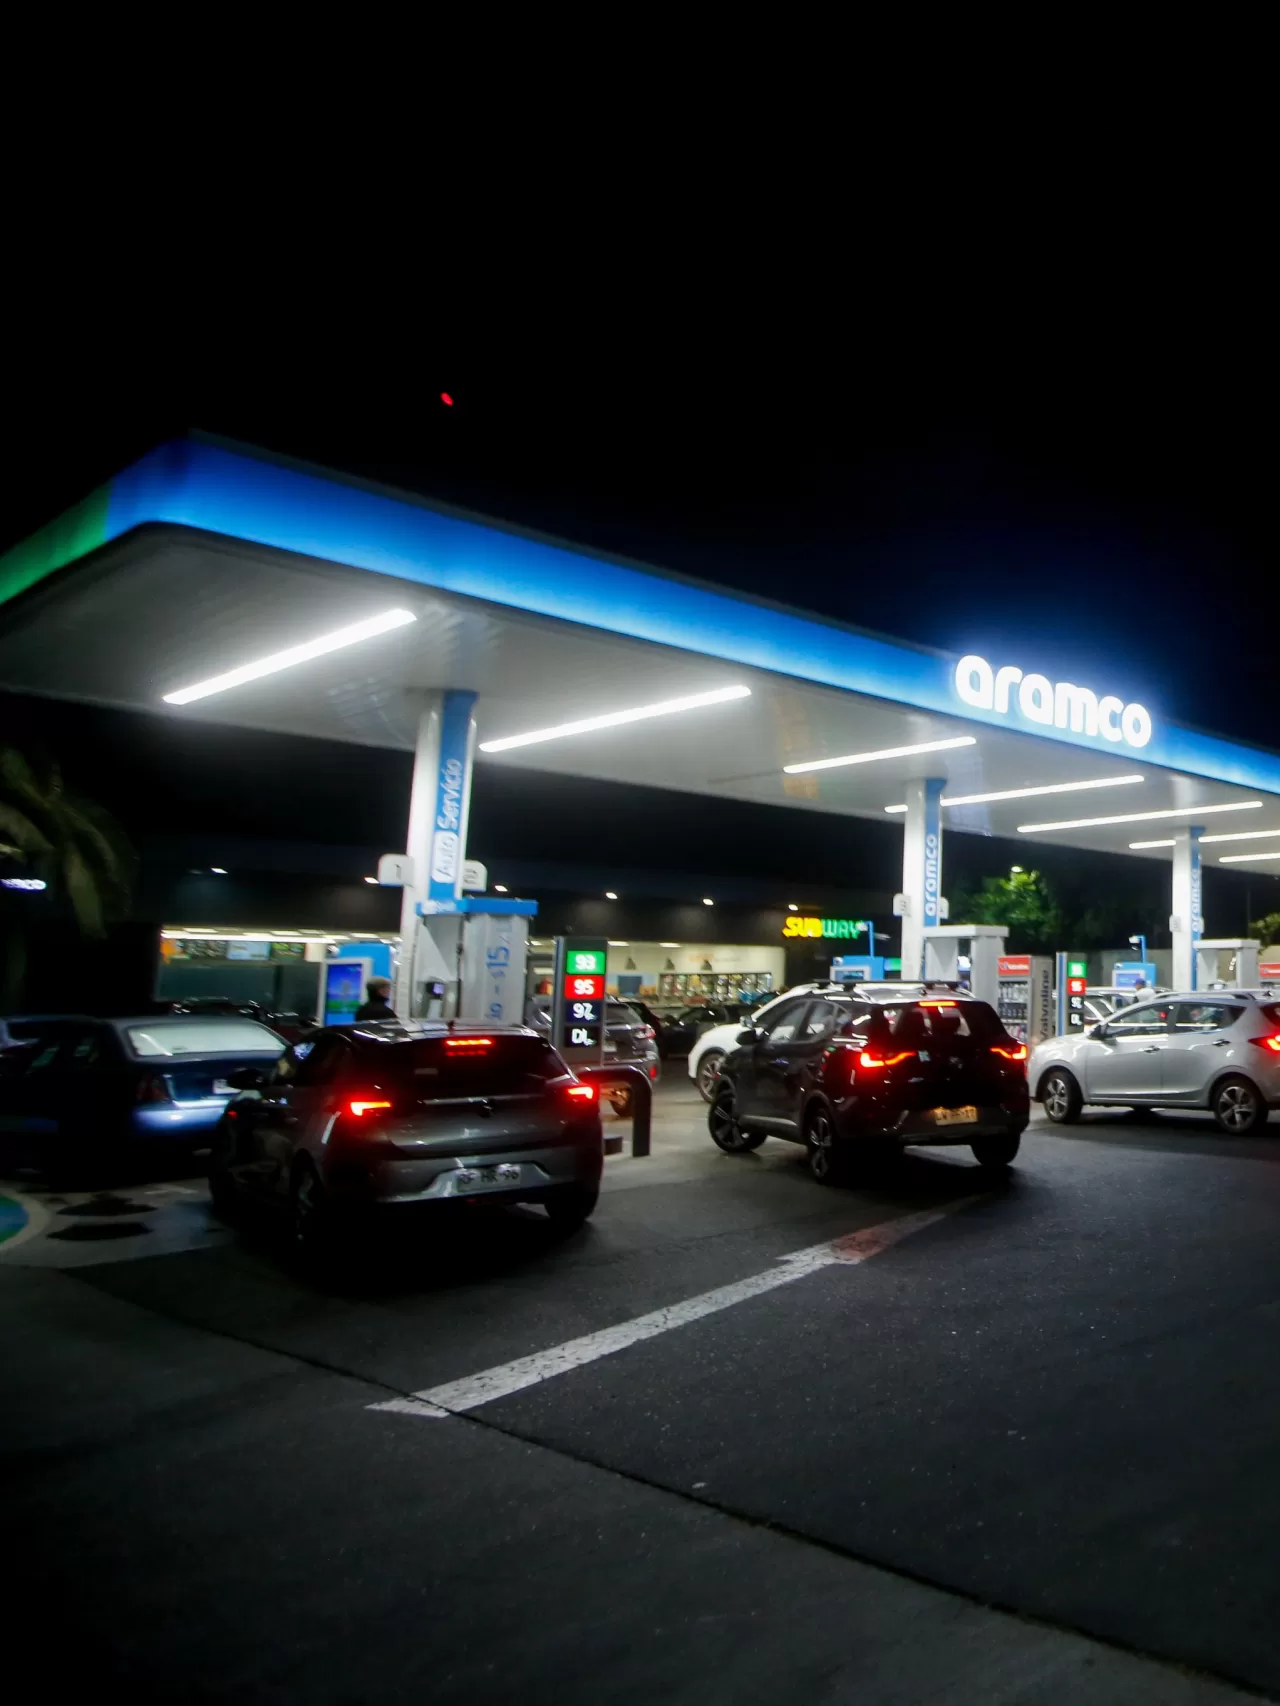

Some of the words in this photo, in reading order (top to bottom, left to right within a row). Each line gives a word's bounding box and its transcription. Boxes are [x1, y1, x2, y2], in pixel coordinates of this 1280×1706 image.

[955, 655, 1151, 748] aramco
[437, 758, 463, 830] Servicio
[925, 834, 937, 917] aramco
[574, 979, 595, 995] 95
[575, 954, 597, 970] 93
